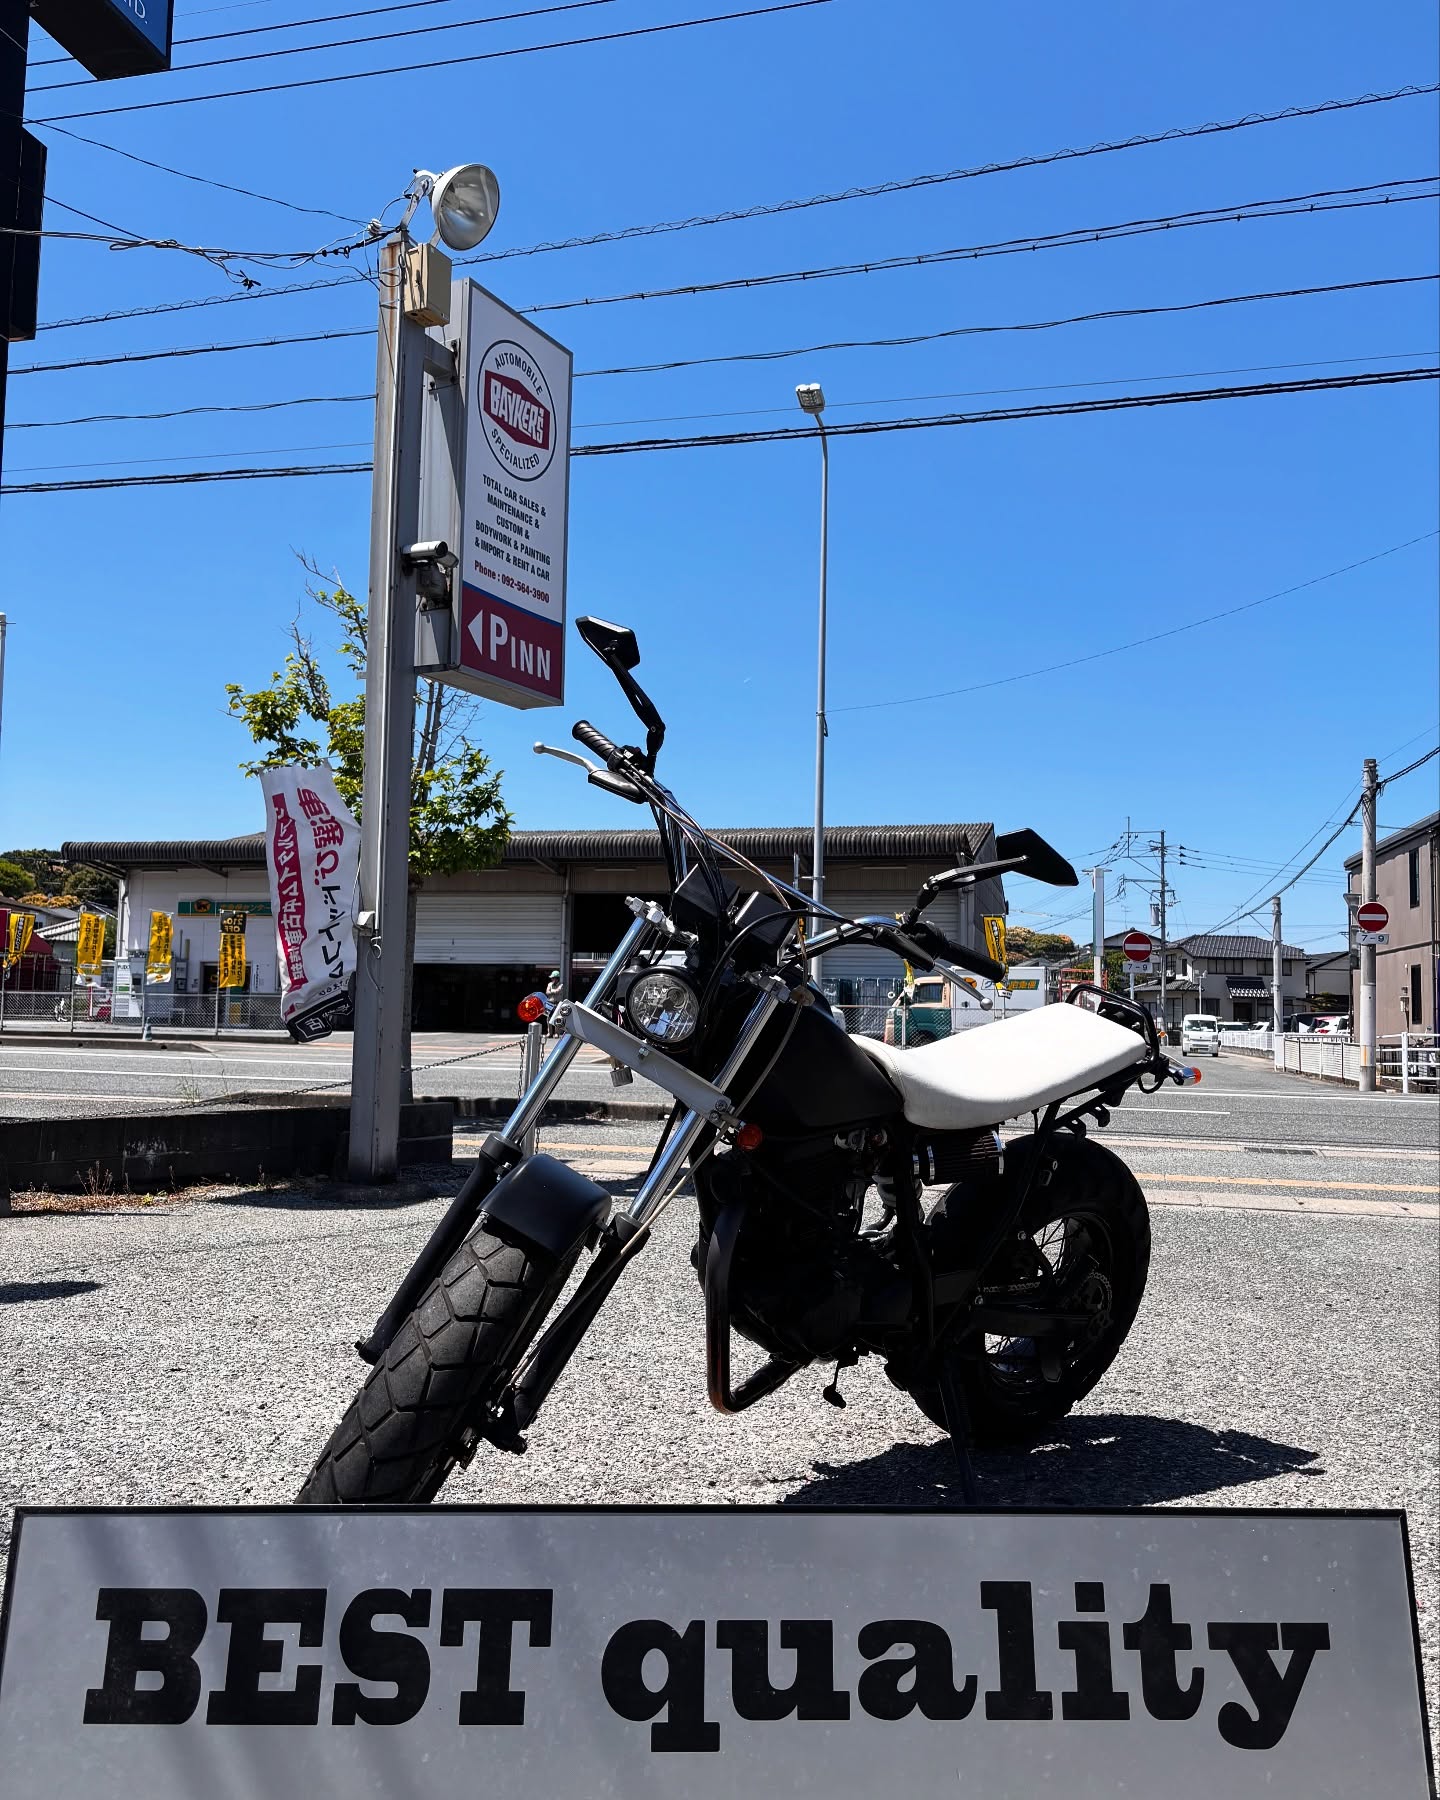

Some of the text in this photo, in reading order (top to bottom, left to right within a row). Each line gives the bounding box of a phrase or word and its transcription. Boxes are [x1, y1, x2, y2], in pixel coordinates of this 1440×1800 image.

[494, 352, 543, 395] AUTOMOBILE
[491, 428, 540, 470] SPECIALIZED
[483, 474, 546, 517] TOTAL CAR SALES &
[487, 493, 540, 530] MAINTENANCE &
[475, 519, 550, 566] BODYWORK & PAINTING
[496, 514, 530, 540] CUSTOM &
[474, 536, 550, 581] & IMPORT & RENT A CAR
[474, 559, 496, 580] Phone
[501, 573, 550, 604] 092-564-3900
[490, 613, 550, 681] PINN
[83, 1580, 1330, 1752] BEST quality
